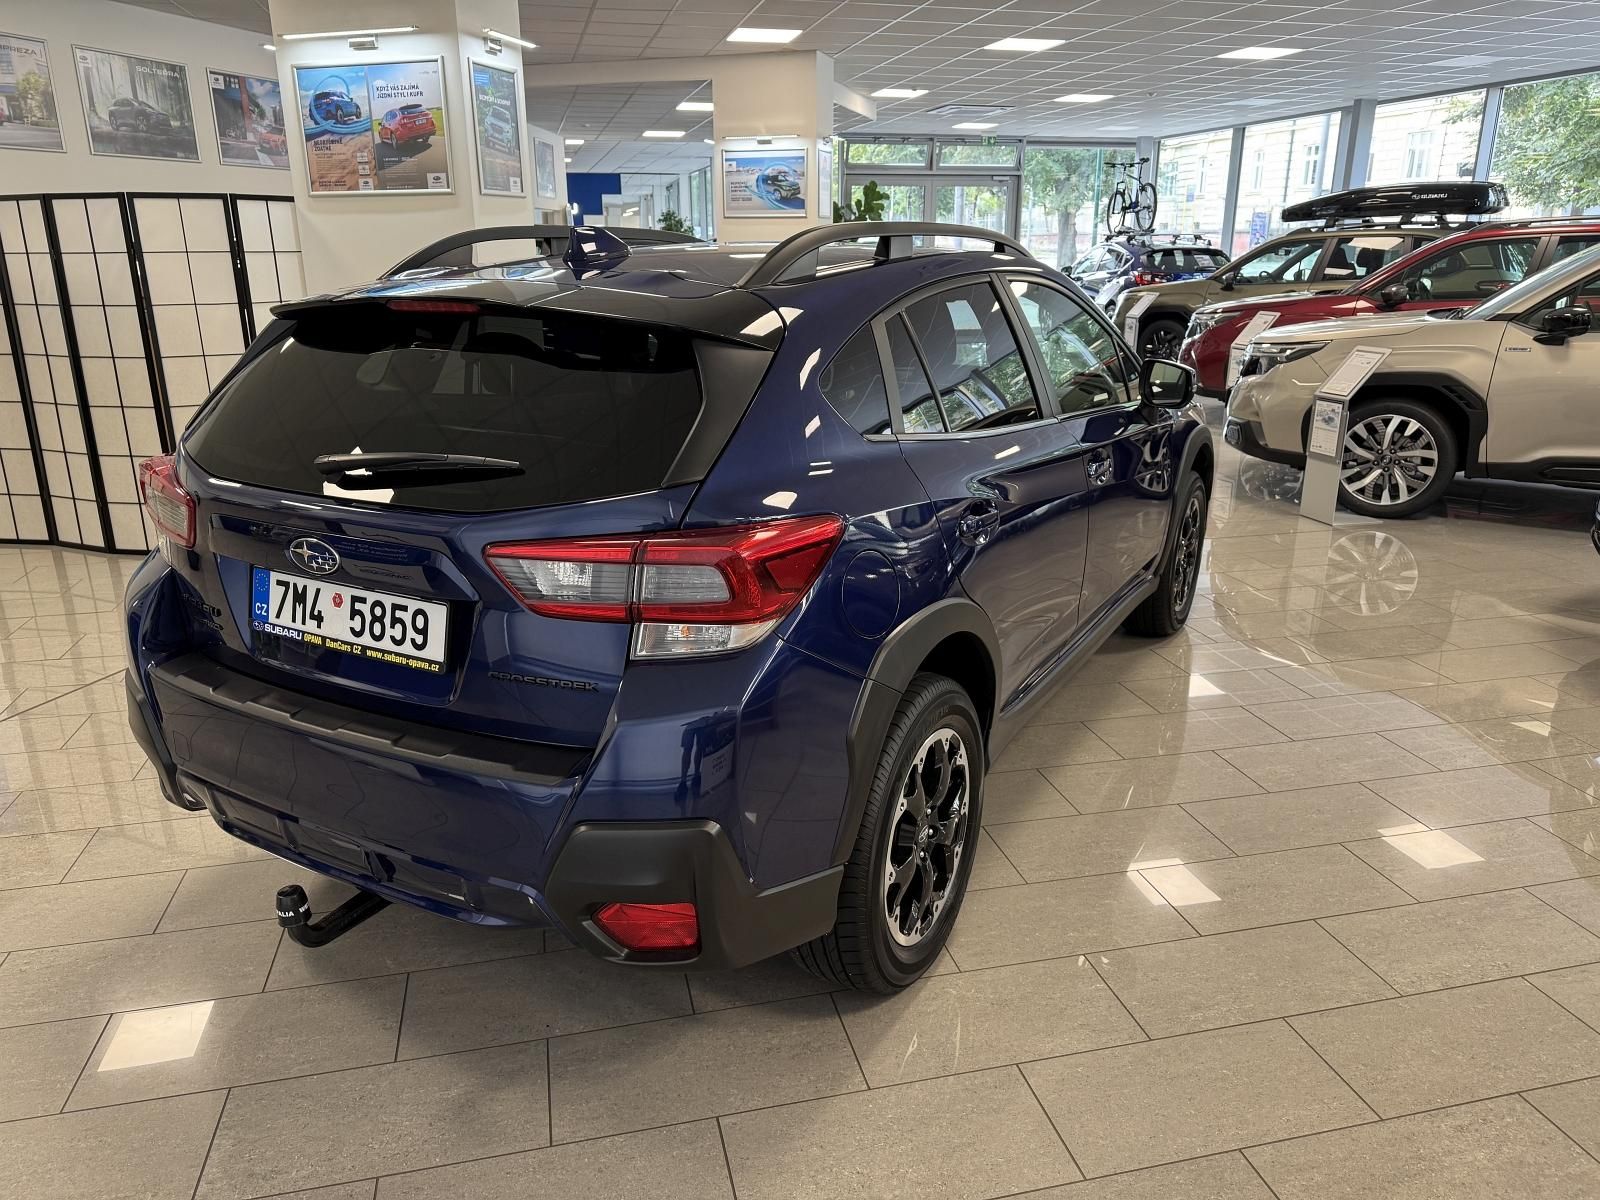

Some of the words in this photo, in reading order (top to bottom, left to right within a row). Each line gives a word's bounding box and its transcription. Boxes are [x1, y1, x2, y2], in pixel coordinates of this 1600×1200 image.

[0, 44, 37, 56] PREZA
[135, 65, 180, 79] SOLTERRA
[255, 602, 268, 616] CZ
[274, 579, 324, 629] 7M4
[349, 594, 429, 651] 5859
[264, 623, 303, 641] SUBARU
[303, 632, 323, 645] OPAVA
[325, 638, 352, 652] DanCars
[352, 645, 362, 655] CZ
[366, 649, 440, 672] www.subaru-opava.cz
[487, 670, 600, 693] CROSSTREK
